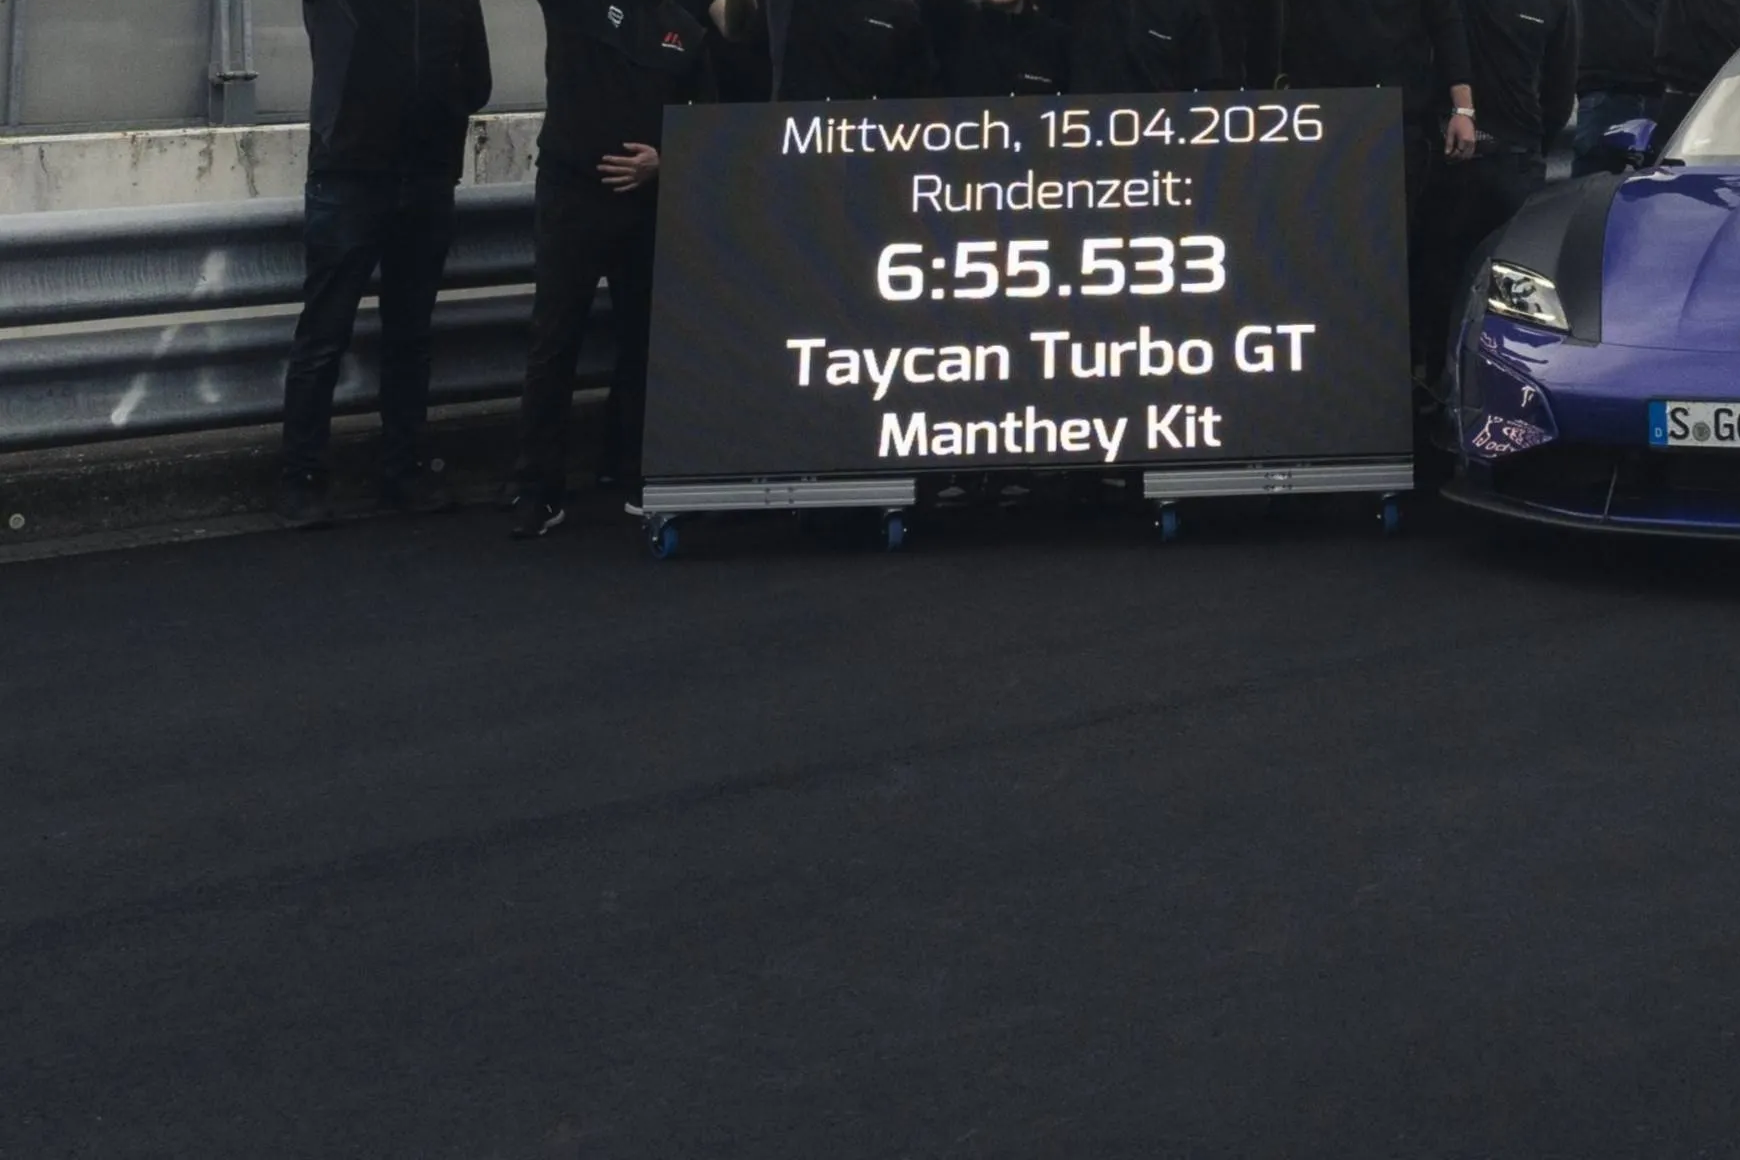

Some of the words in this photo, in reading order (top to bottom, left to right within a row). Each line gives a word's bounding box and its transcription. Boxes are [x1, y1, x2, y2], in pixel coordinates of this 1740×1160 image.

[783, 108, 1022, 154] Mittwoch,
[1041, 104, 1323, 148] 15.04.2026
[912, 170, 1192, 213] Rundenzeit:
[877, 235, 1226, 301] 6:55.533
[786, 337, 1009, 401] Taycan
[1030, 326, 1214, 380] Turbo
[1234, 323, 1316, 373] GT
[878, 405, 1128, 463] Manthey
[1147, 403, 1222, 450] Kit
[1669, 407, 1690, 440] S
